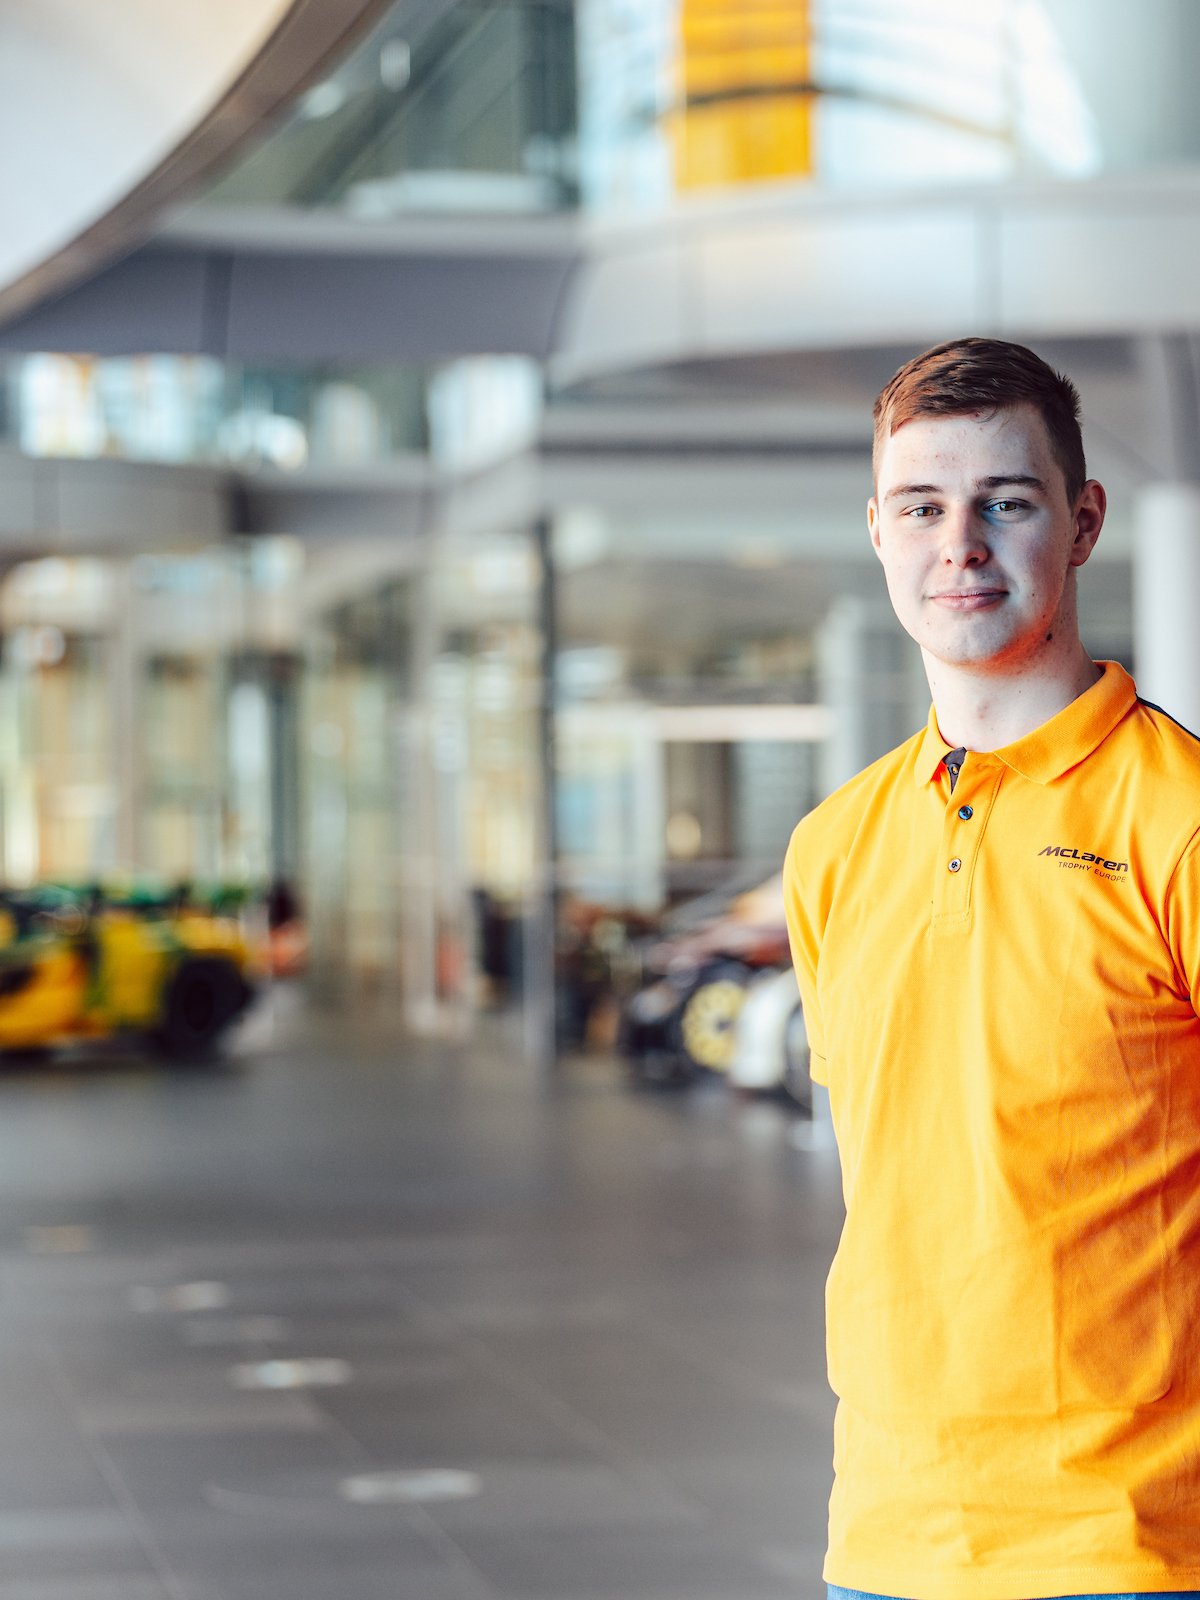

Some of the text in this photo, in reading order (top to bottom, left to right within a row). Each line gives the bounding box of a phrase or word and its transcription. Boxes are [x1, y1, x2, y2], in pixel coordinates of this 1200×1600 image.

[1037, 846, 1129, 872] McLaren
[1058, 861, 1126, 883] TROPHY EUROPE
